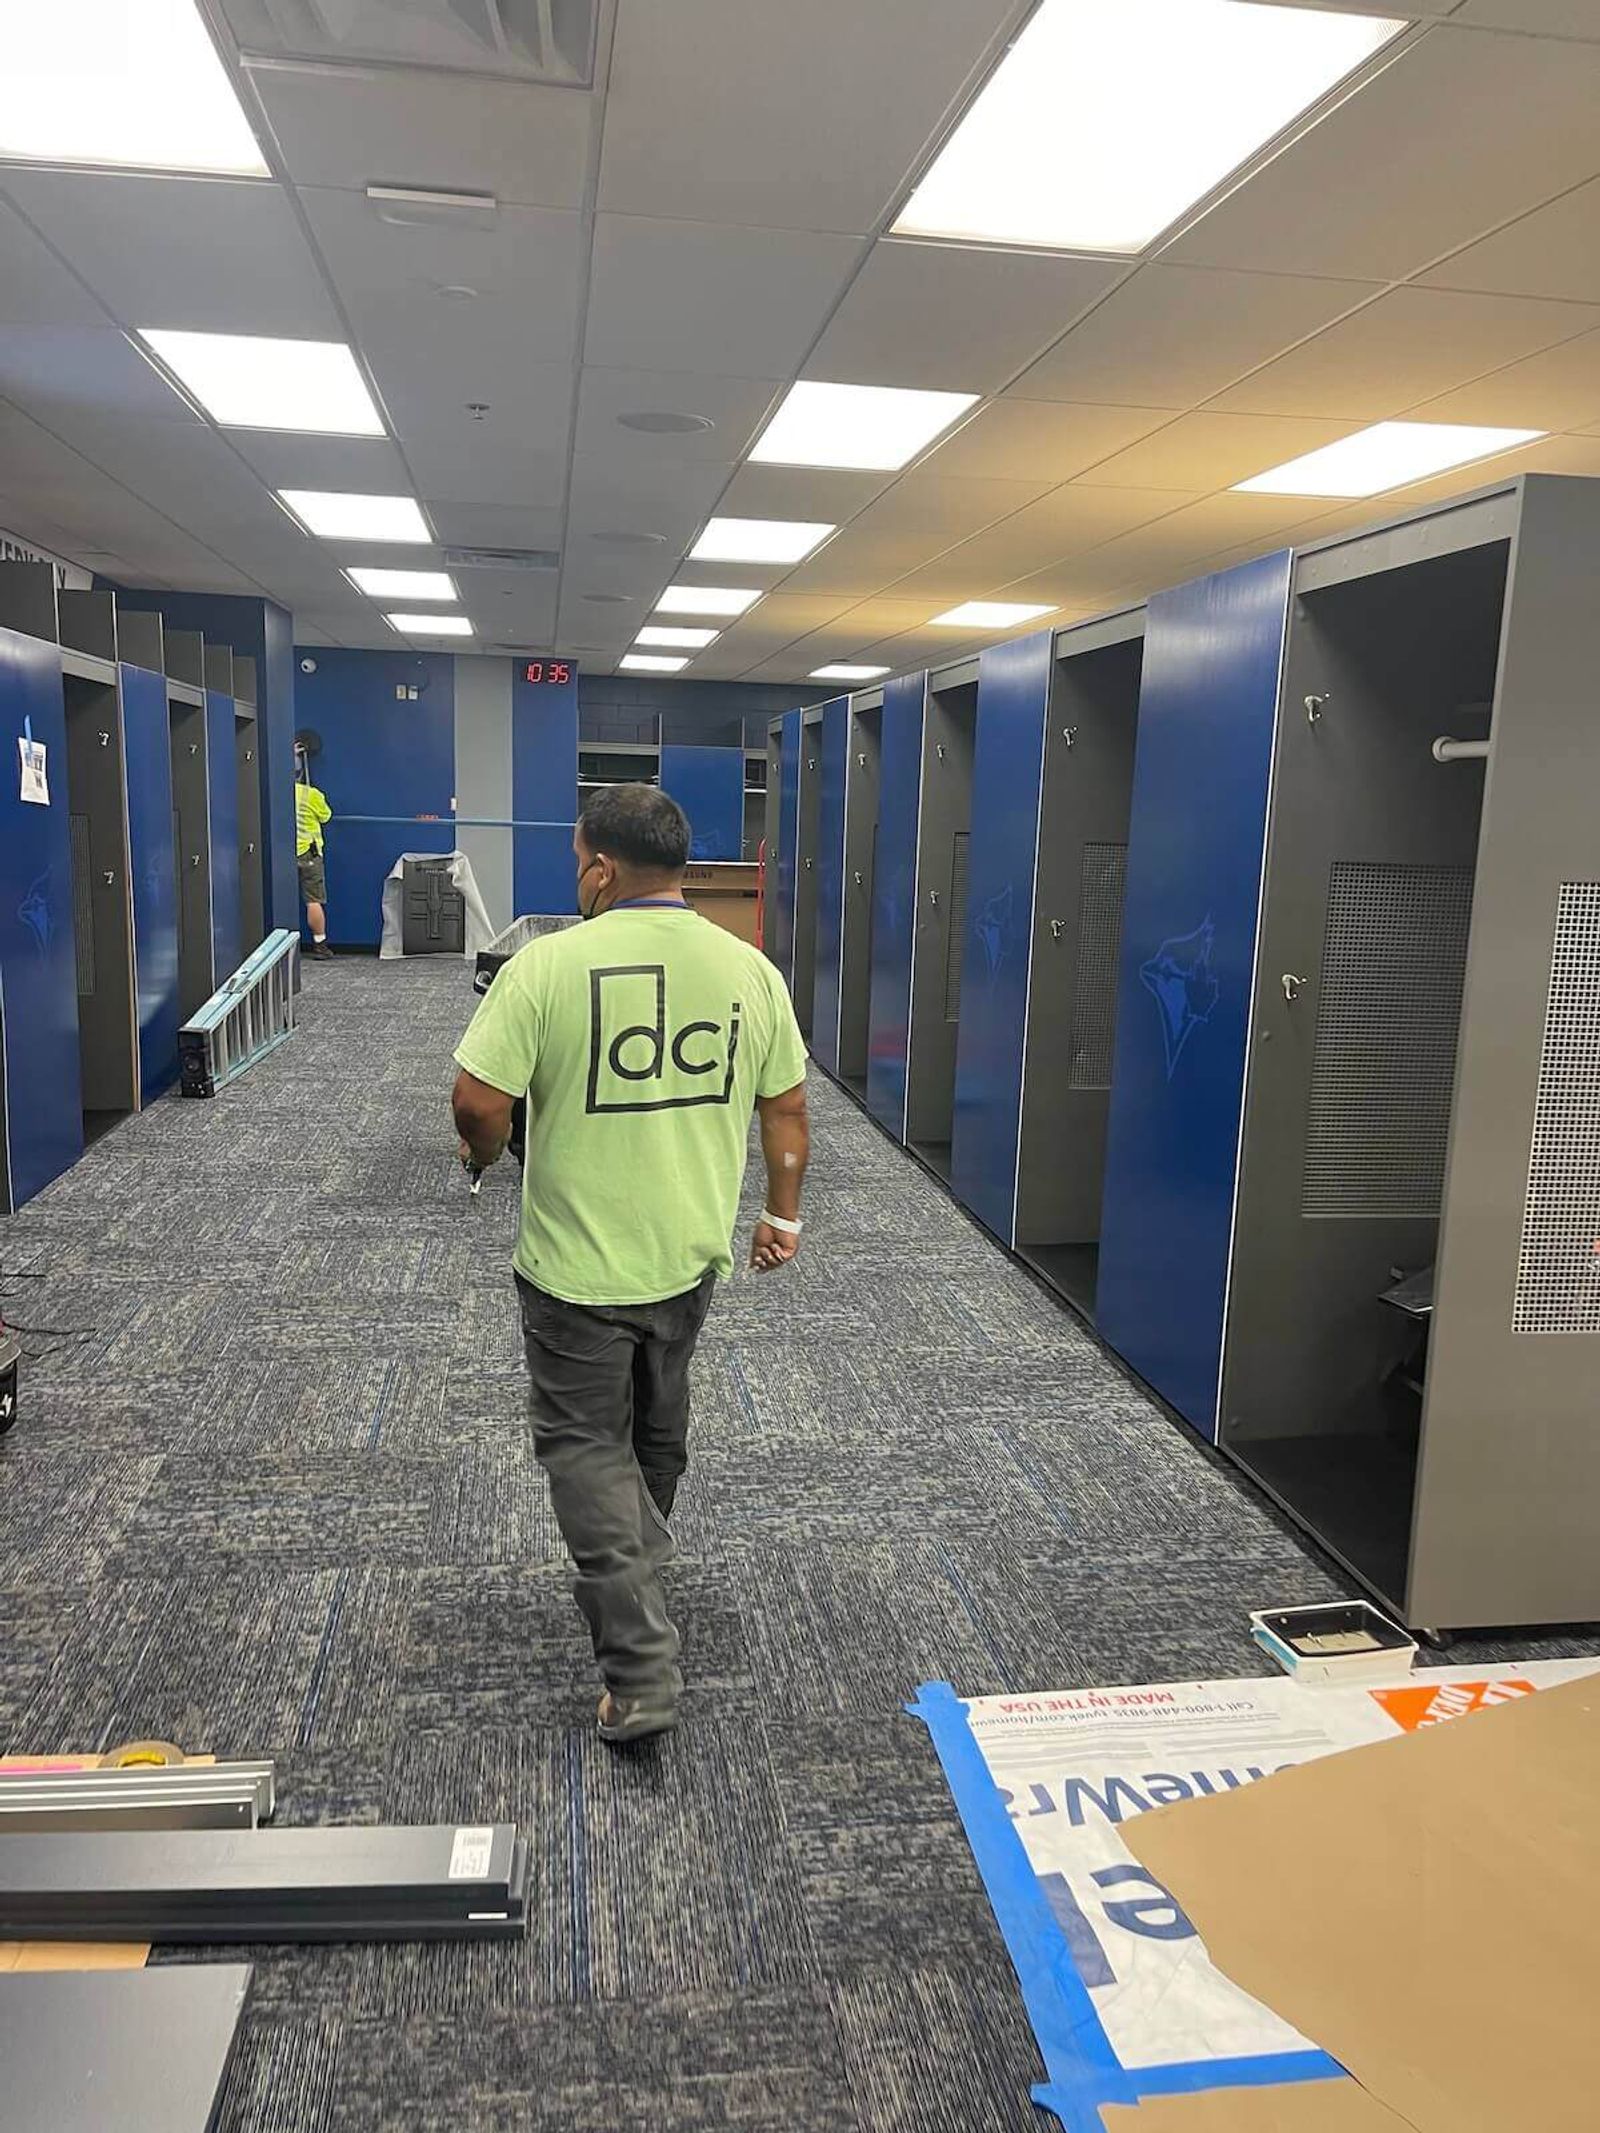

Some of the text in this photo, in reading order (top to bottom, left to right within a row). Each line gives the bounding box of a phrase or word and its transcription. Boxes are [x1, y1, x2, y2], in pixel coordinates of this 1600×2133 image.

[586, 965, 741, 1114] dci
[999, 1692, 1175, 1713] MADE IN THE USA
